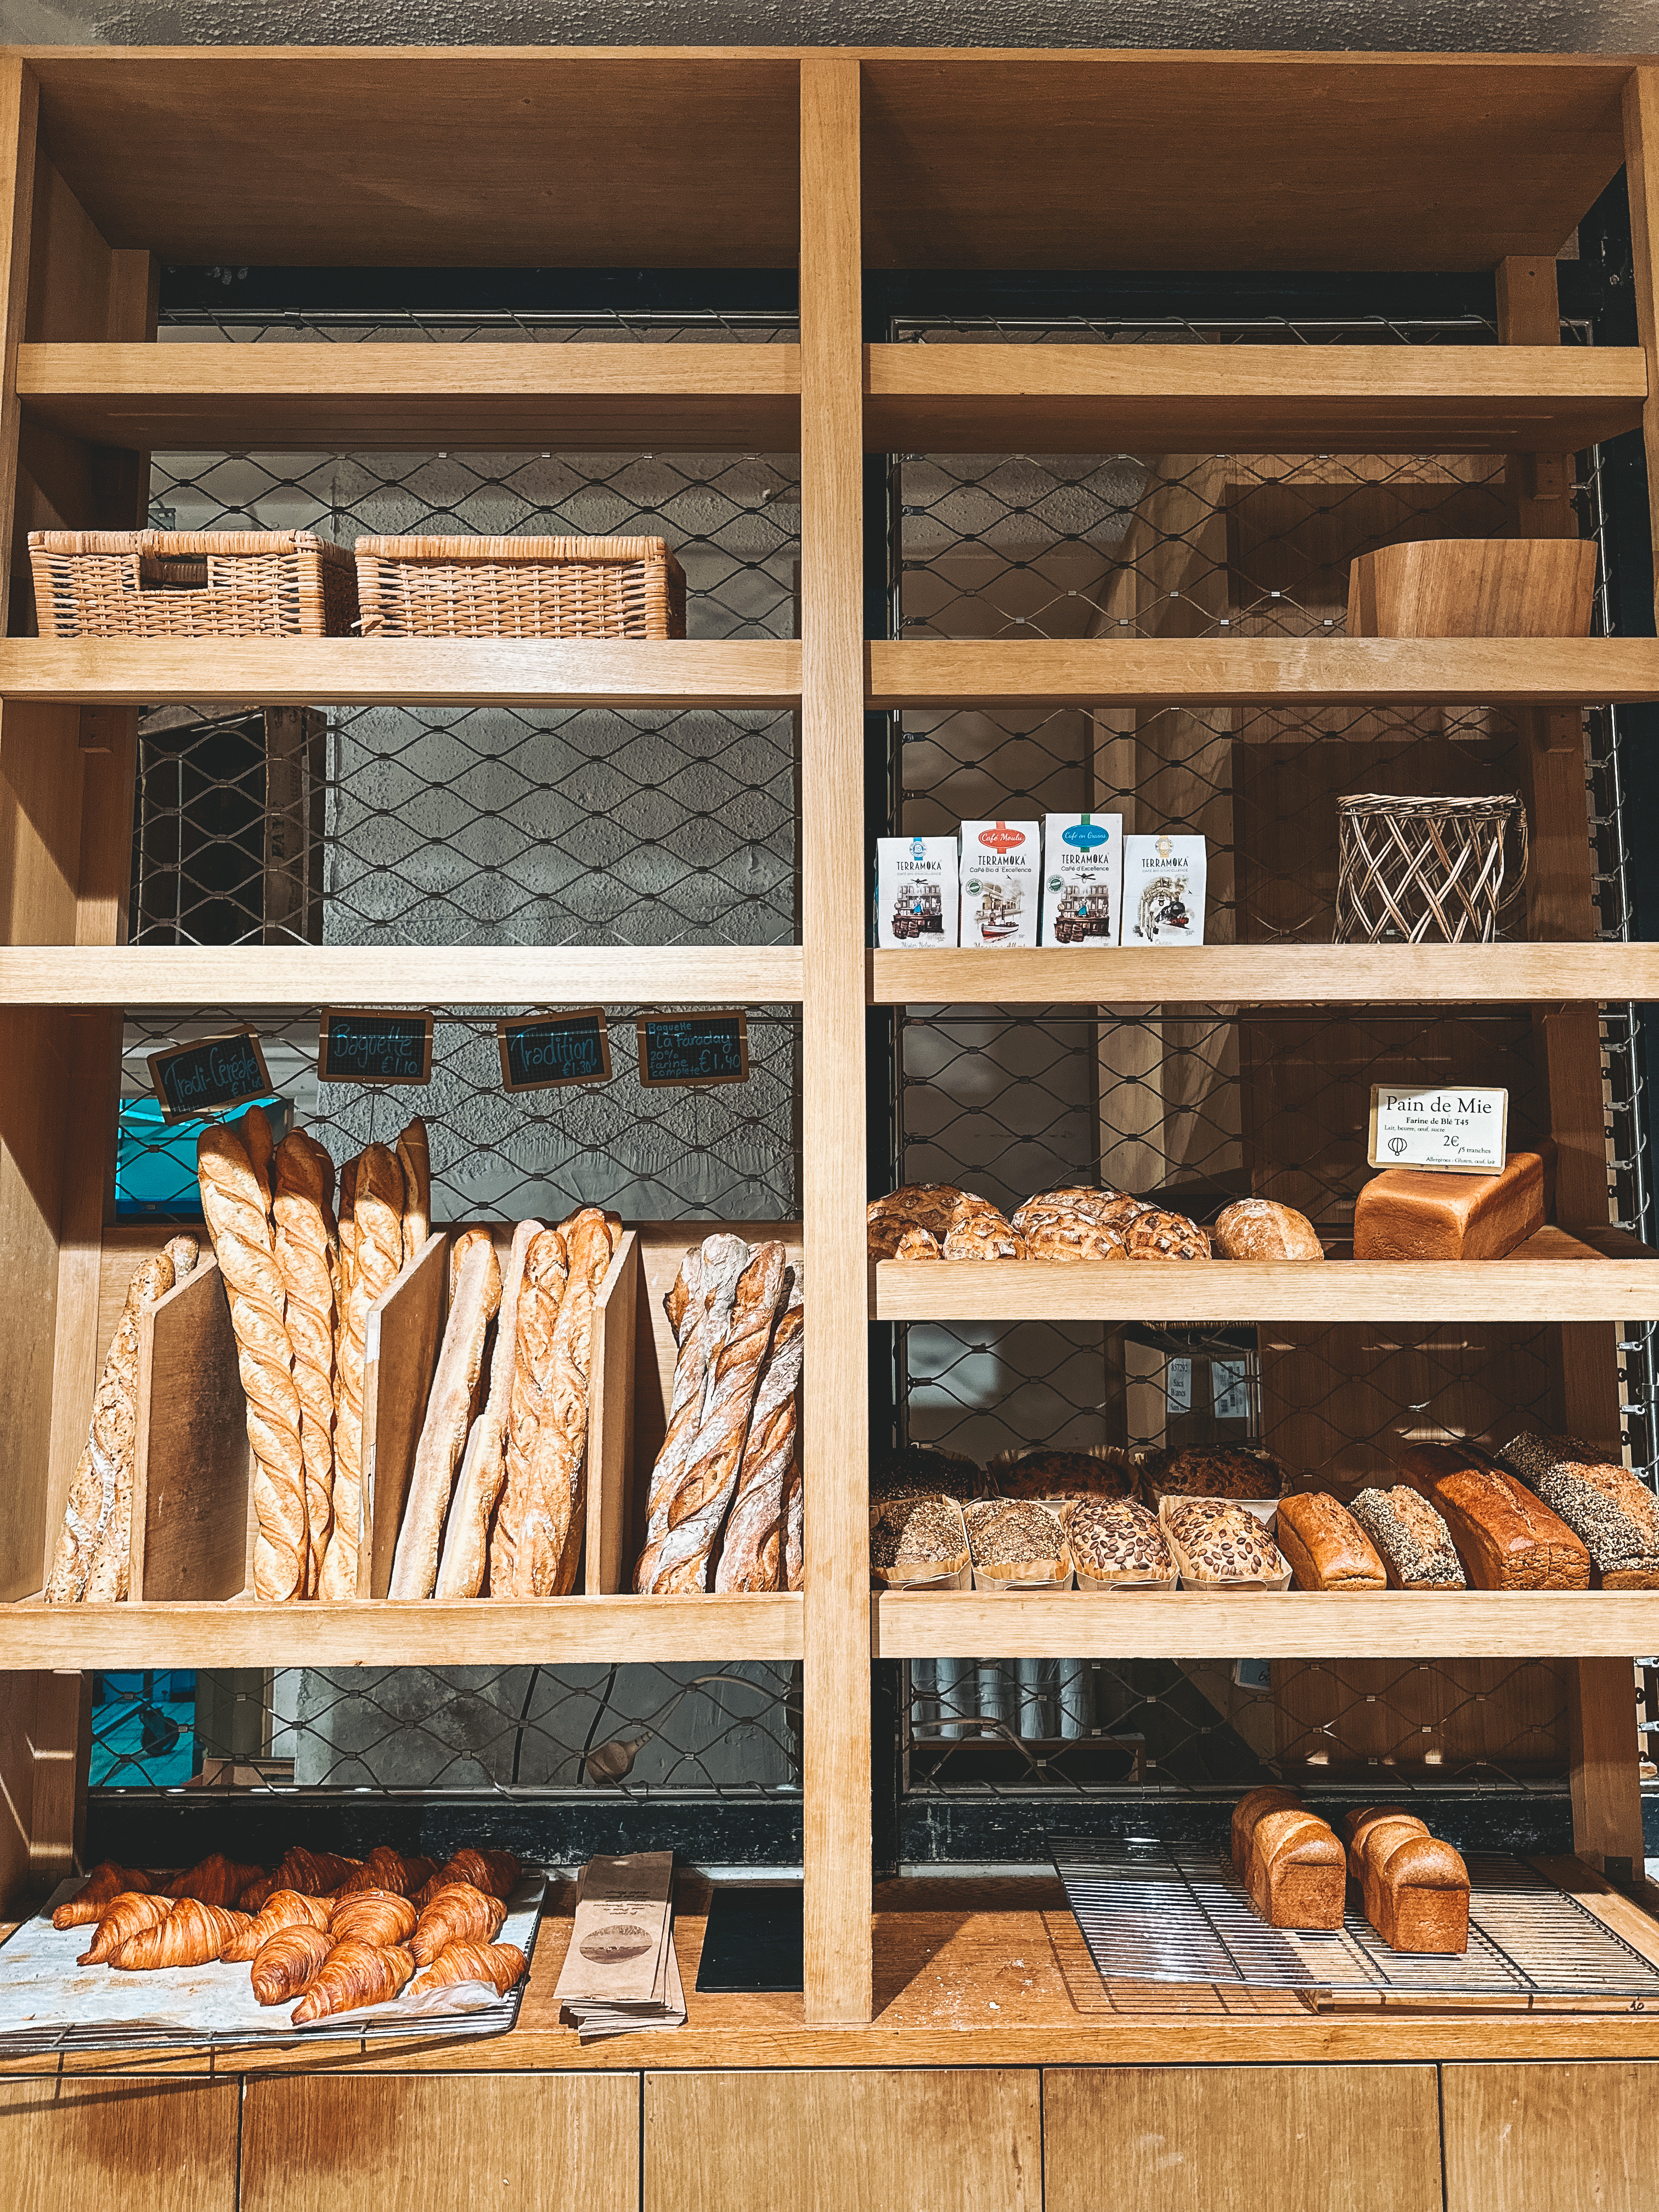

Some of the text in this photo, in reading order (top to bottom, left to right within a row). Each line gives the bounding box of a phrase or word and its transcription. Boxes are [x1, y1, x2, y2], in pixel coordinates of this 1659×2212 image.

[981, 833, 1024, 843] Café Moulu
[1065, 831, 1077, 840] Café
[978, 855, 1026, 866] TERRAMOKA
[1061, 854, 1109, 864] TERRAMOKA
[1142, 857, 1188, 868] TERRAMOKA
[896, 861, 941, 871] TERRAMOKA
[648, 1022, 692, 1035] Baguette
[332, 1023, 412, 1068] Baguette
[674, 1030, 733, 1054] Faraday
[511, 1027, 597, 1072] Tradition
[650, 1049, 679, 1061] 20%
[650, 1059, 689, 1070] farine
[1386, 1095, 1492, 1114] Pain de Mie
[1443, 1135, 1459, 1147] 2€
